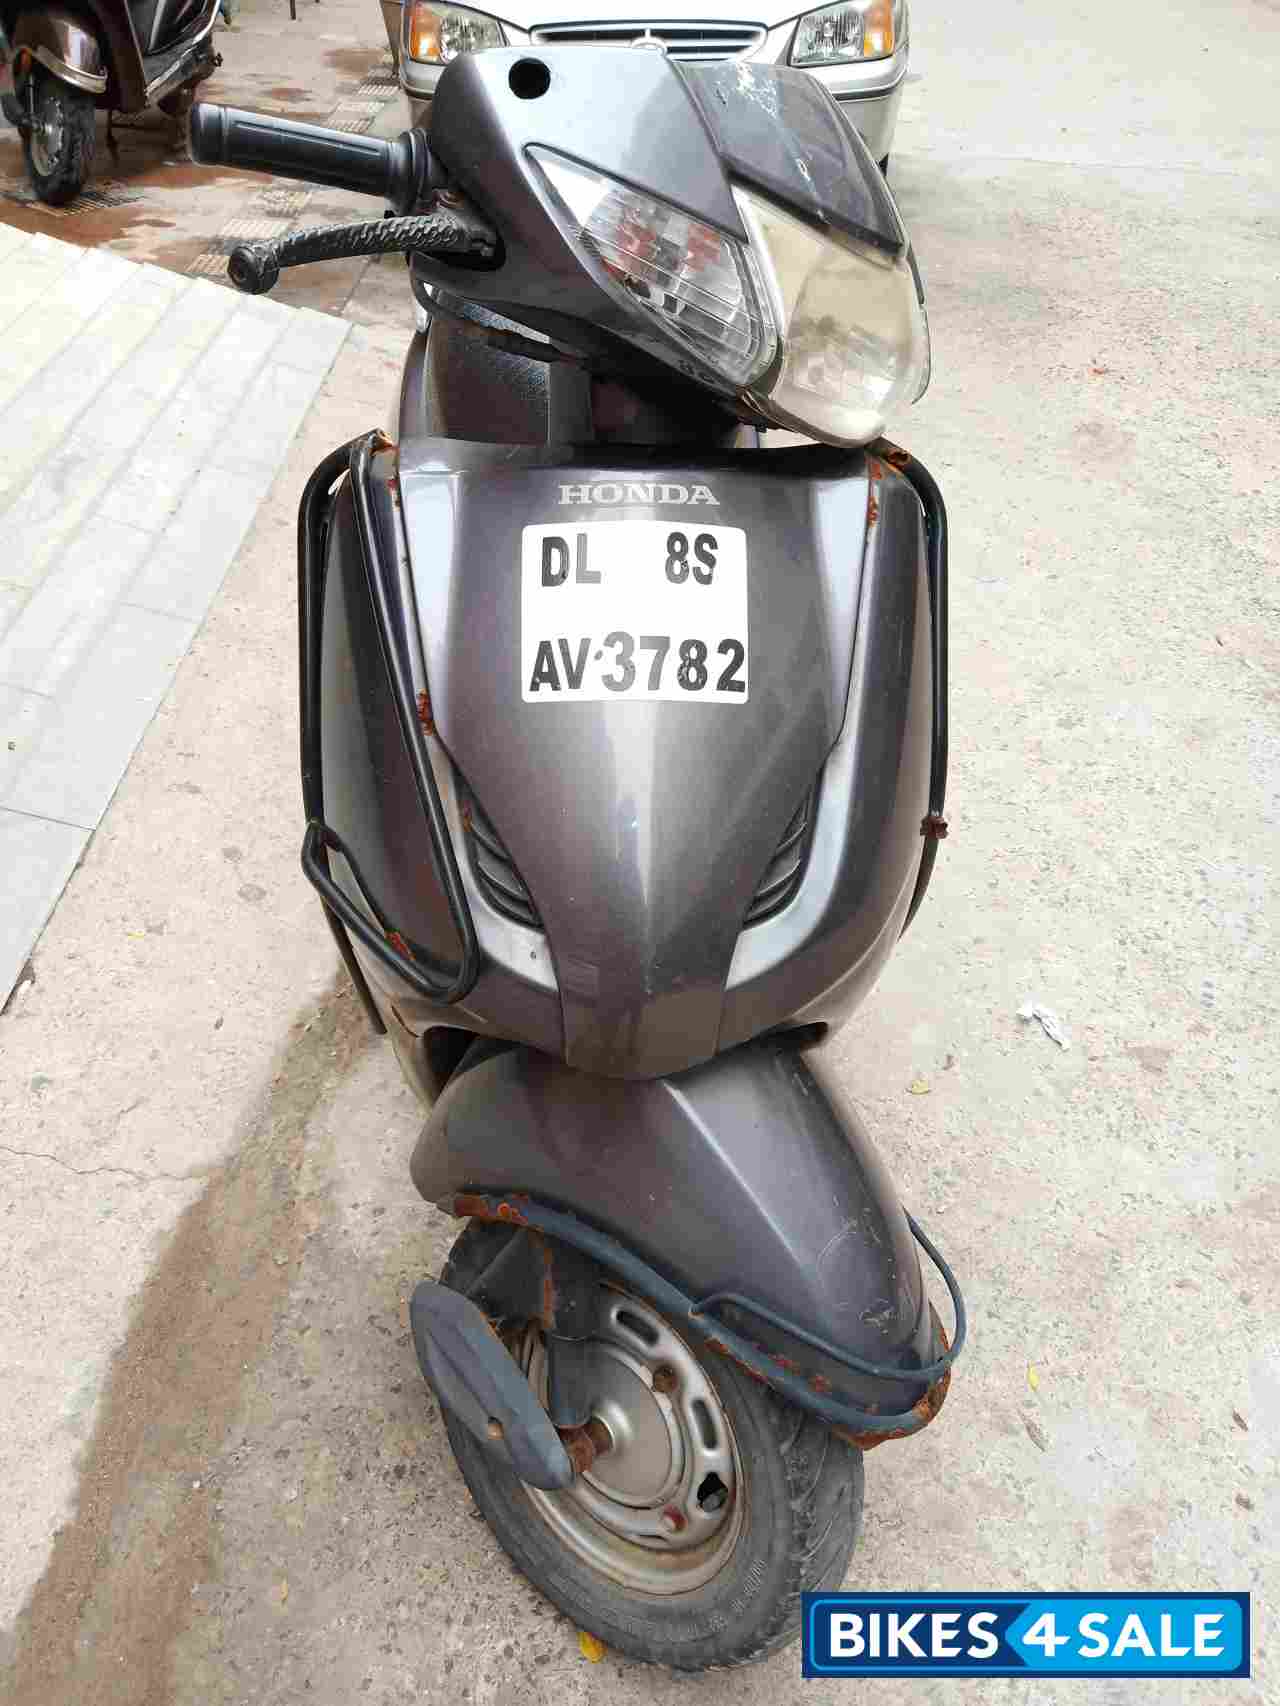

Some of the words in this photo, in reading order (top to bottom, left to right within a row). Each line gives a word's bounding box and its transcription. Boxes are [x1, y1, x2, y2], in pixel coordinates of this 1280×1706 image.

[558, 483, 720, 505] HONDA
[541, 533, 602, 587] DL
[665, 531, 719, 585] 8S
